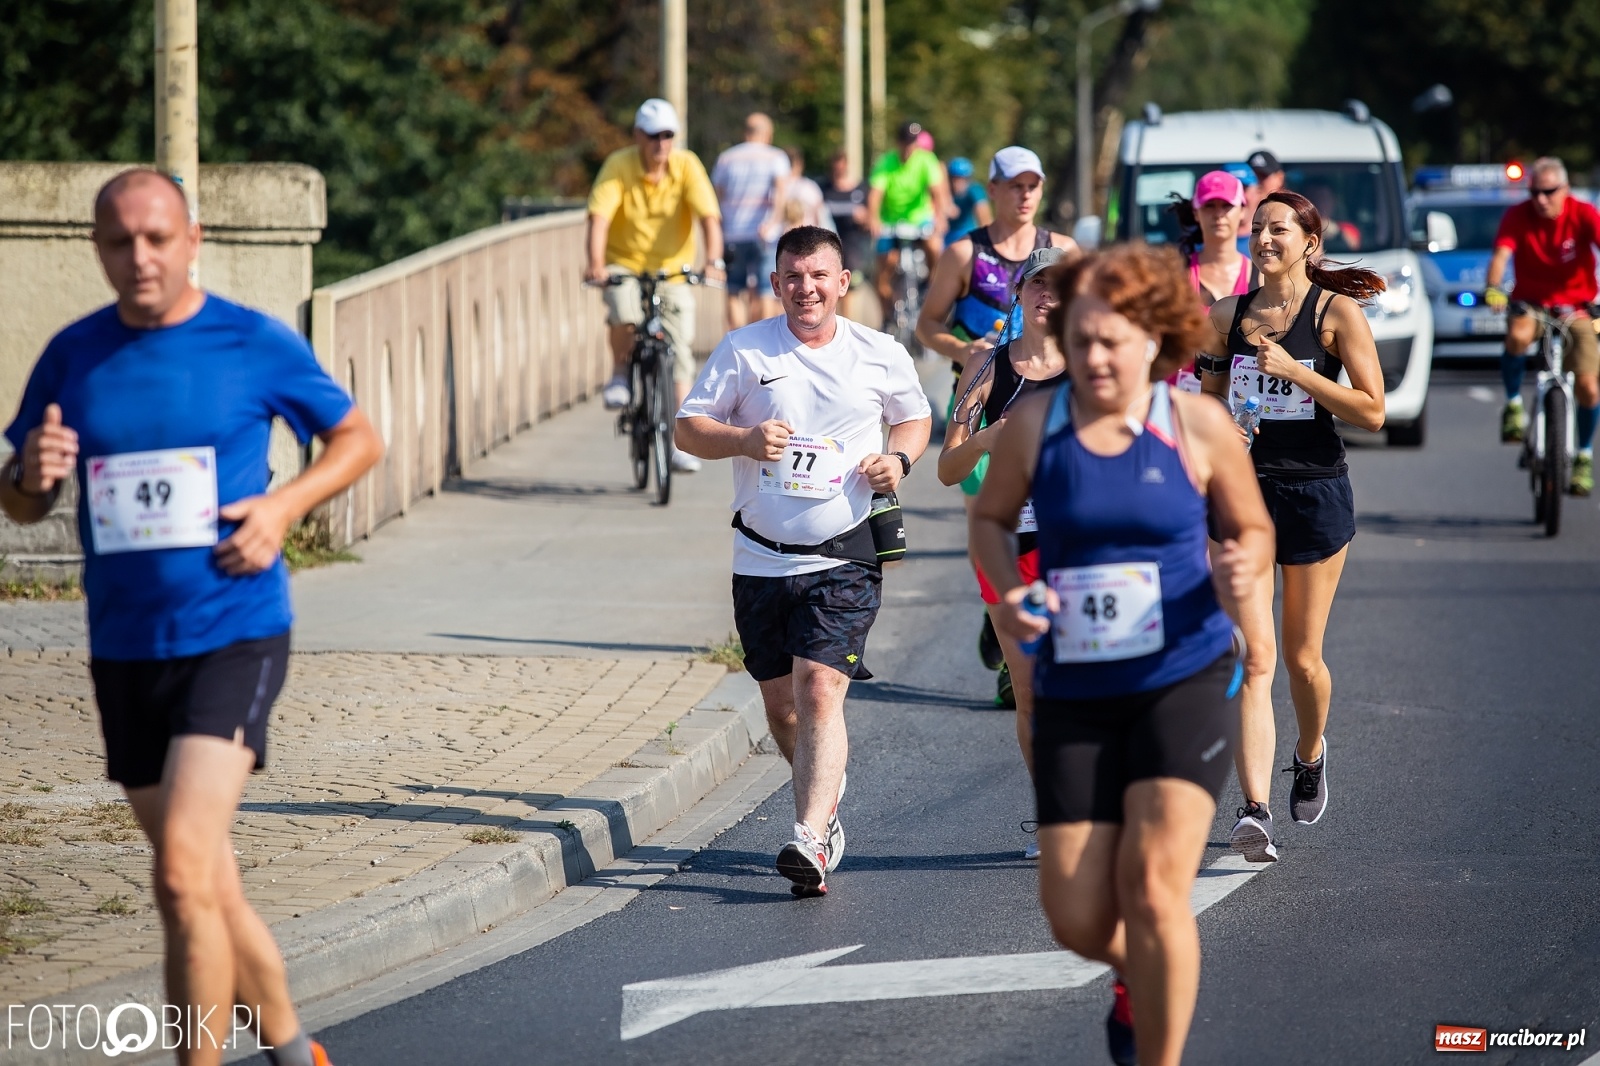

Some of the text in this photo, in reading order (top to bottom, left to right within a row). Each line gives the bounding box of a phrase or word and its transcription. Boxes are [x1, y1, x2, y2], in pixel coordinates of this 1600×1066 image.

[1256, 374, 1293, 397] 128
[792, 450, 817, 473] 77
[135, 481, 172, 508] 49
[1082, 593, 1118, 622] 48
